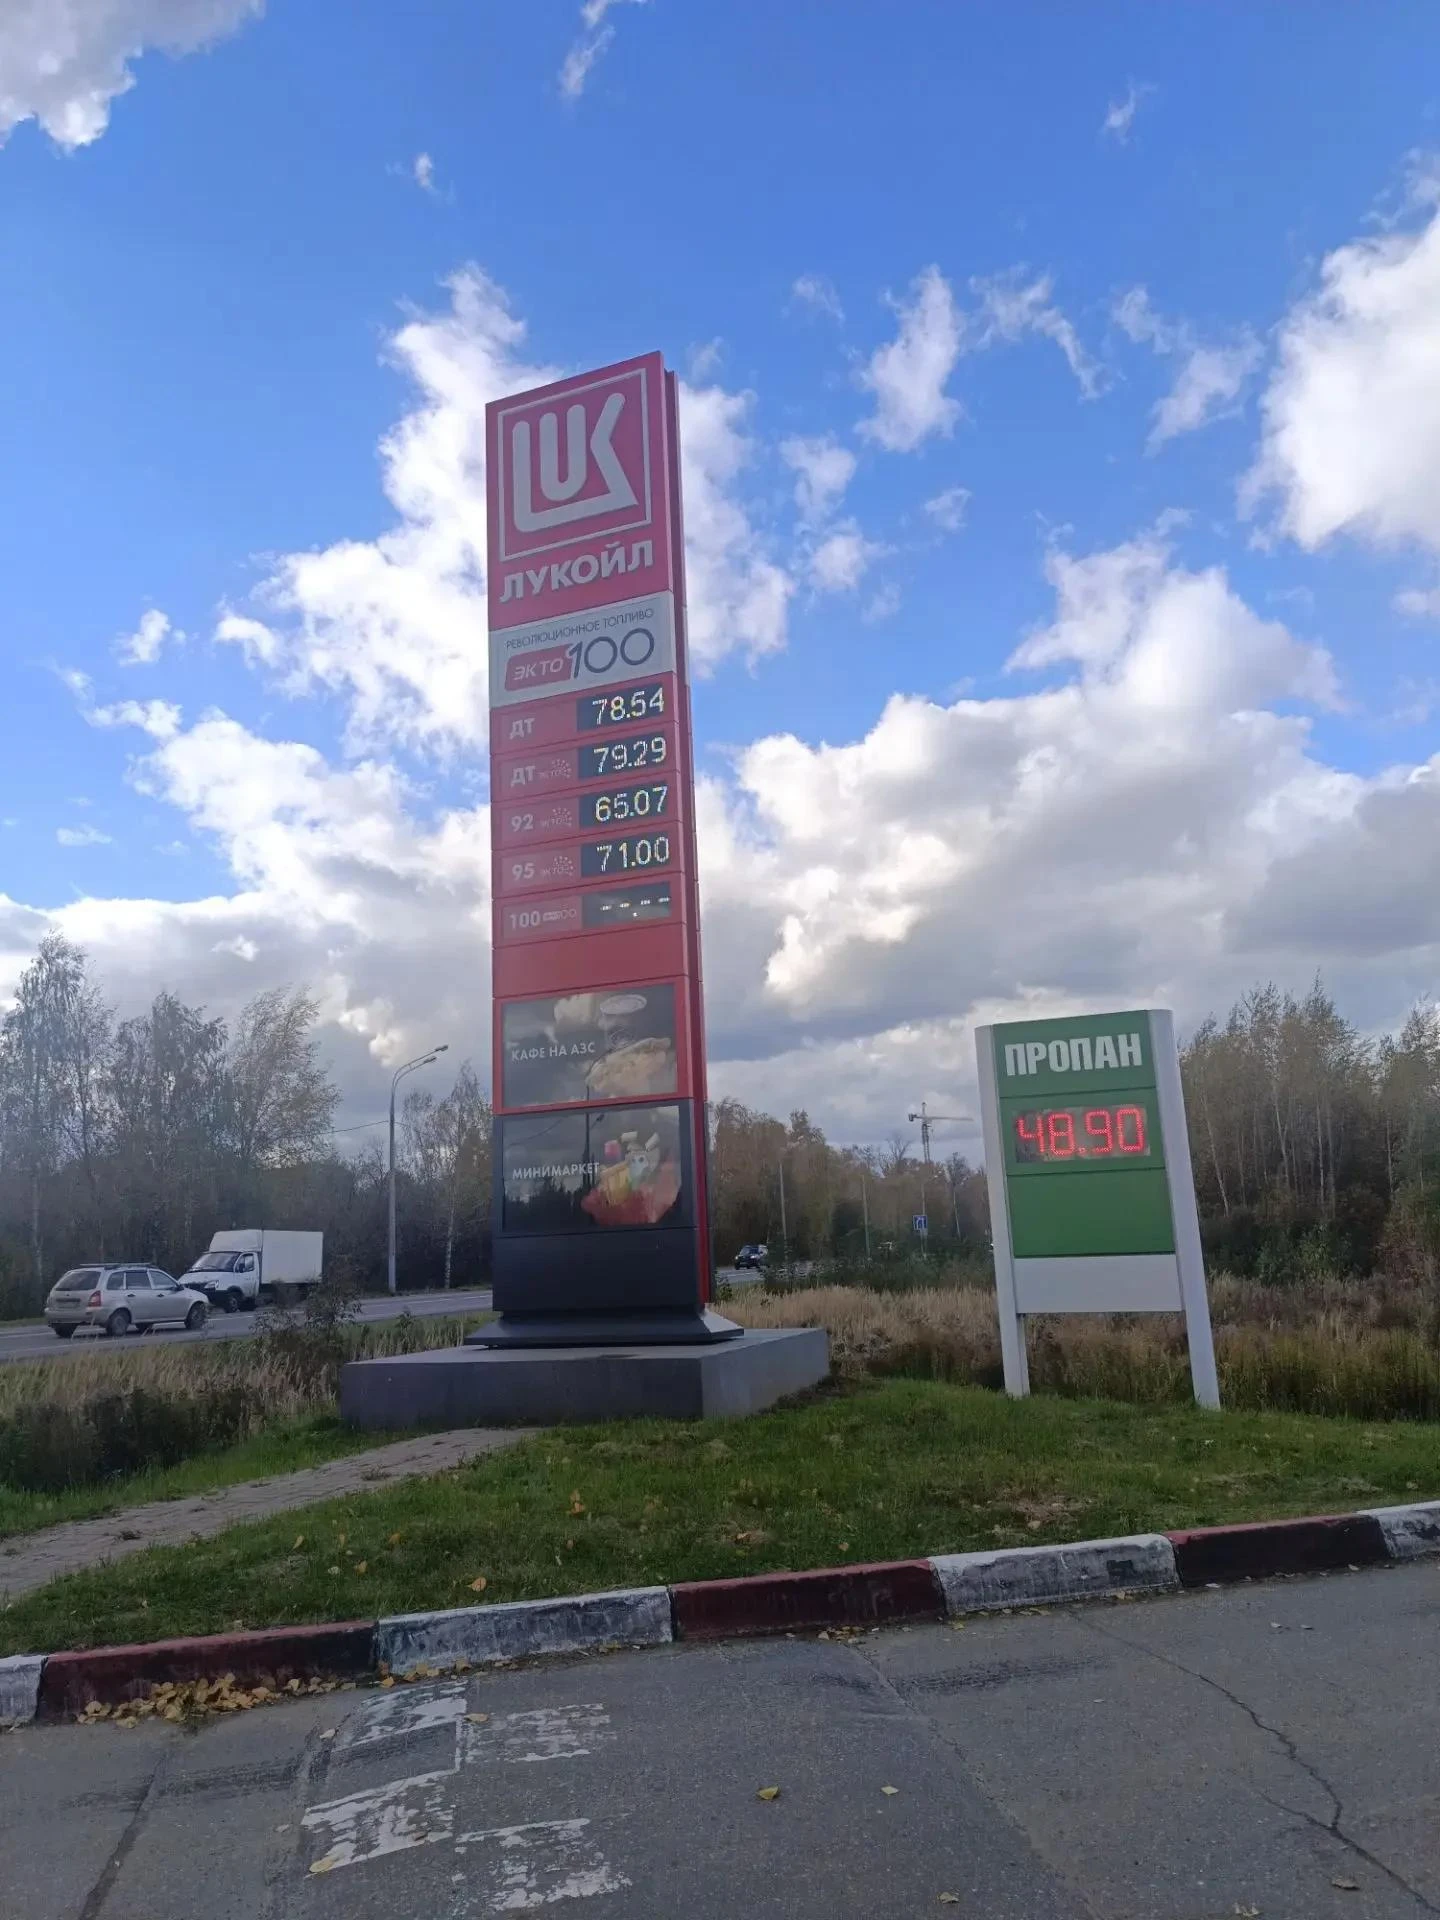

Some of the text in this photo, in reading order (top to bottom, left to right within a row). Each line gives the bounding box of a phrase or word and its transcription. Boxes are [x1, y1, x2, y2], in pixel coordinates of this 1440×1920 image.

[500, 539, 653, 603] ЛУКОЙЛ
[505, 608, 655, 650] РЕВОЛЮЦИОННОЕ ТОПЛИВО
[513, 627, 655, 682] ЭКТО 100
[509, 687, 665, 740] ДТ 78.54
[510, 764, 536, 788] ДТ
[594, 736, 667, 774] 79.29
[511, 813, 534, 833] 92
[595, 785, 668, 822] 65.07
[512, 862, 536, 882] 95
[596, 836, 670, 872] 71.00
[510, 910, 541, 929] 100
[511, 1042, 596, 1062] КАФЕ НА АЗС
[1004, 1032, 1143, 1077] ПРОПАН
[1016, 1107, 1146, 1157] 48.90
[512, 1162, 600, 1180] МИНИМАРКЕТ
